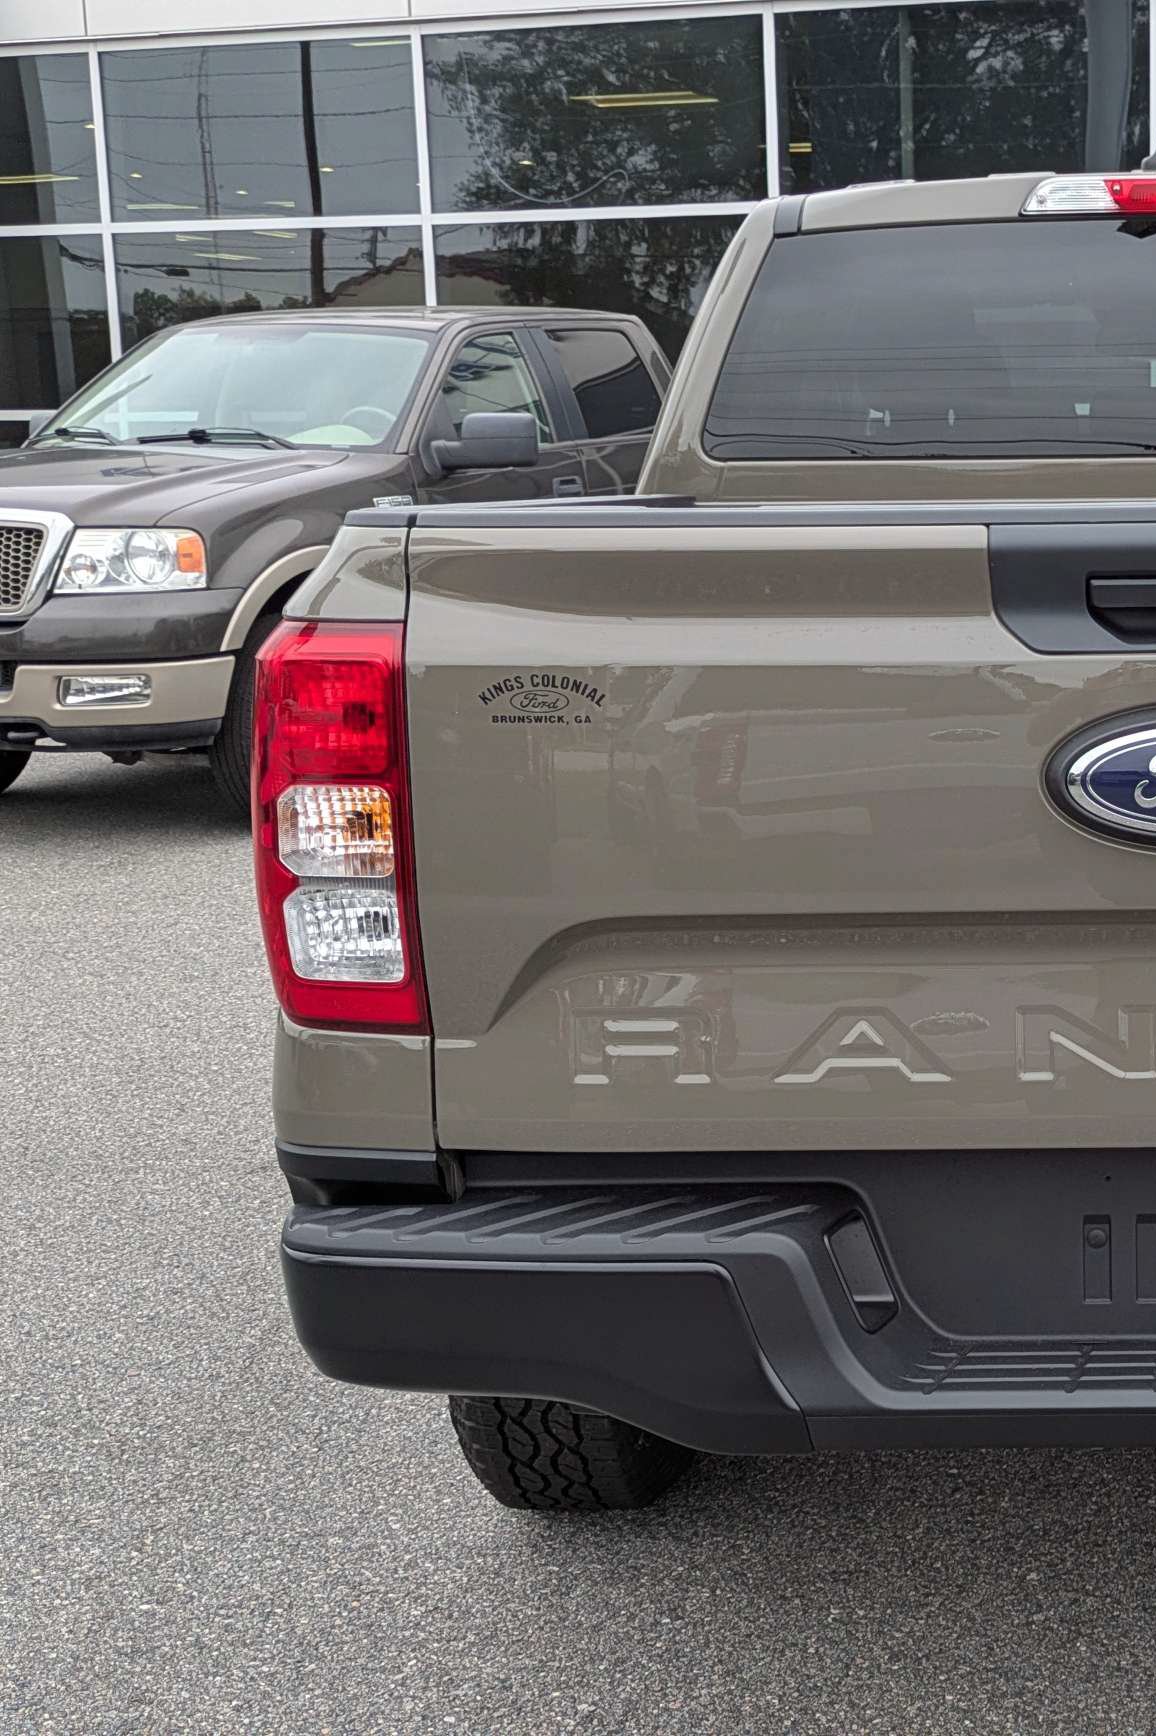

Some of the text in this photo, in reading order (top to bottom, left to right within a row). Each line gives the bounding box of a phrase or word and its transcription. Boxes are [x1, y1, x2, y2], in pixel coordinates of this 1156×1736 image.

[478, 673, 606, 708] KINGS COLONIAL
[519, 692, 560, 709] Ford
[491, 715, 592, 726] BRUNSWICK, GA
